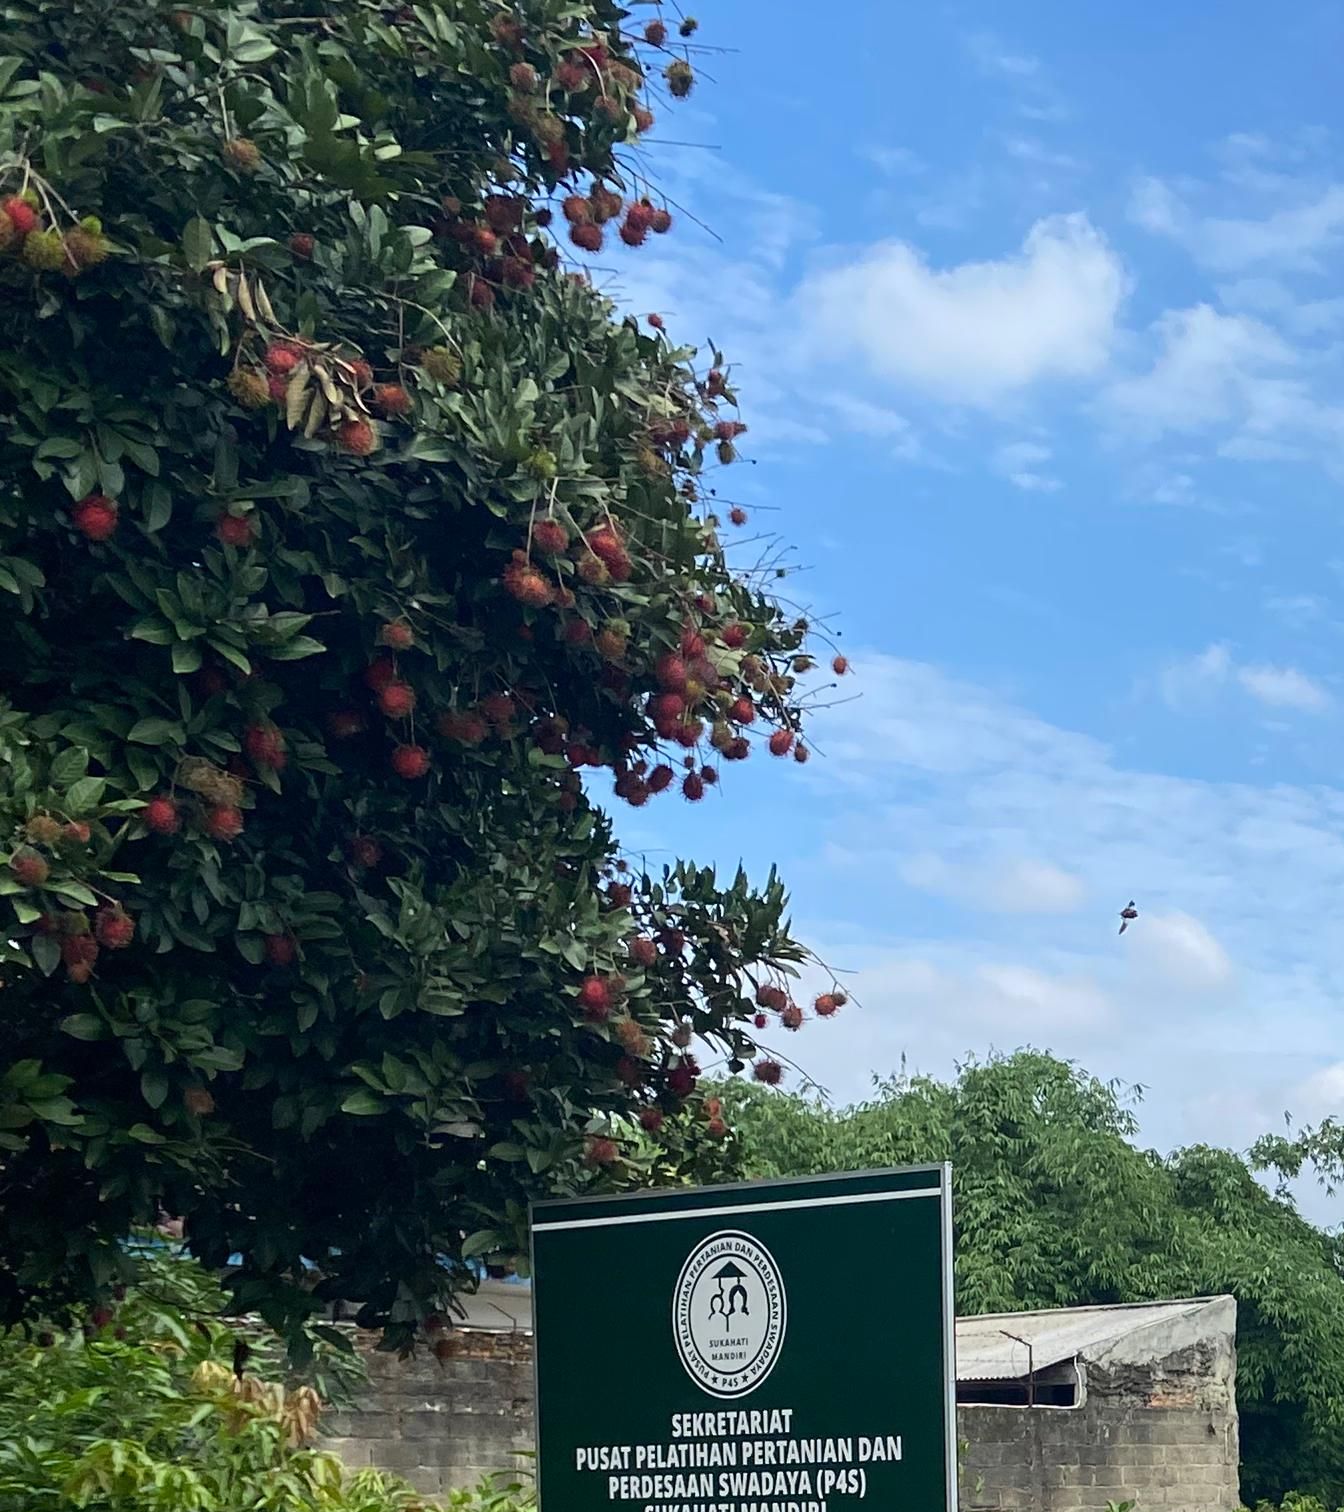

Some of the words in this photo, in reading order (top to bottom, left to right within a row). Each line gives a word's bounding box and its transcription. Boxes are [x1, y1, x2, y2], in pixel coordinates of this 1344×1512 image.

[690, 1241, 732, 1278] PERTANIAN
[735, 1242, 753, 1257] DAN
[681, 1281, 692, 1348] PELATIHAN
[709, 1338, 749, 1348] SUKAHATI
[711, 1352, 746, 1361] MANDIRI
[689, 1349, 709, 1378] PUSAT
[722, 1377, 738, 1387] P4S
[672, 1409, 793, 1437] SEKRETARIAT
[576, 1446, 631, 1470] PUSAT
[636, 1442, 737, 1469] PELATIHAN
[742, 1437, 852, 1466] PERTANIAN
[858, 1435, 902, 1461] DAN
[609, 1473, 714, 1499] PERDESAAN
[719, 1471, 812, 1496] SWADAYA
[817, 1468, 866, 1499] (P4S)
